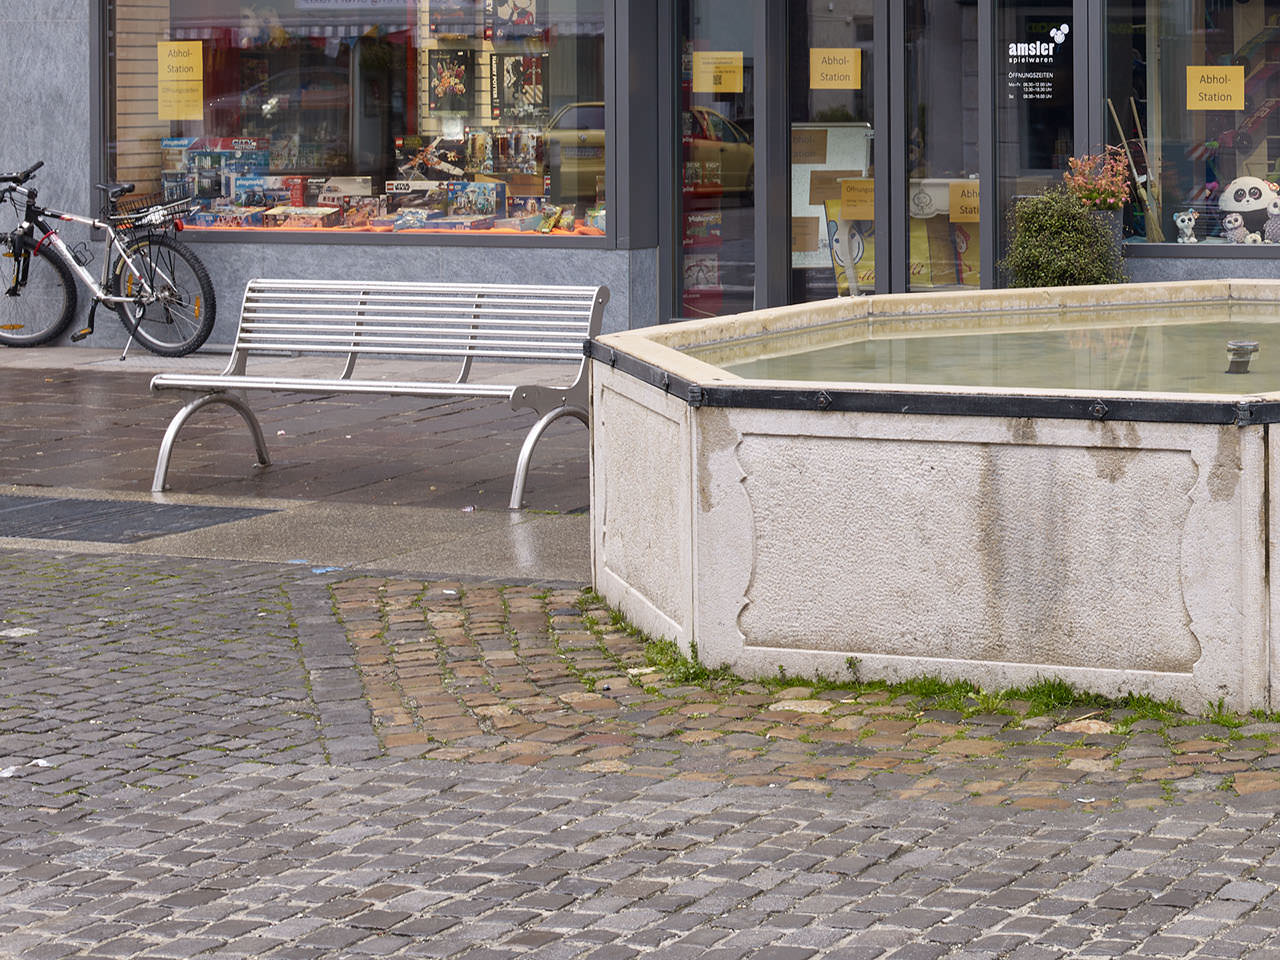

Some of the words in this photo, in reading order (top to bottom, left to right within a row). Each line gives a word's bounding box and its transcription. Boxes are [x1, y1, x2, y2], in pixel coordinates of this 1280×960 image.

[1008, 40, 1055, 56] amsler
[168, 49, 193, 57] Abhol-
[821, 56, 849, 65] Abhol-
[1008, 56, 1054, 64] spielwaren
[167, 64, 194, 73] Station
[820, 72, 851, 81] Station
[1199, 74, 1232, 84] Abhol-
[1198, 92, 1232, 102] Station
